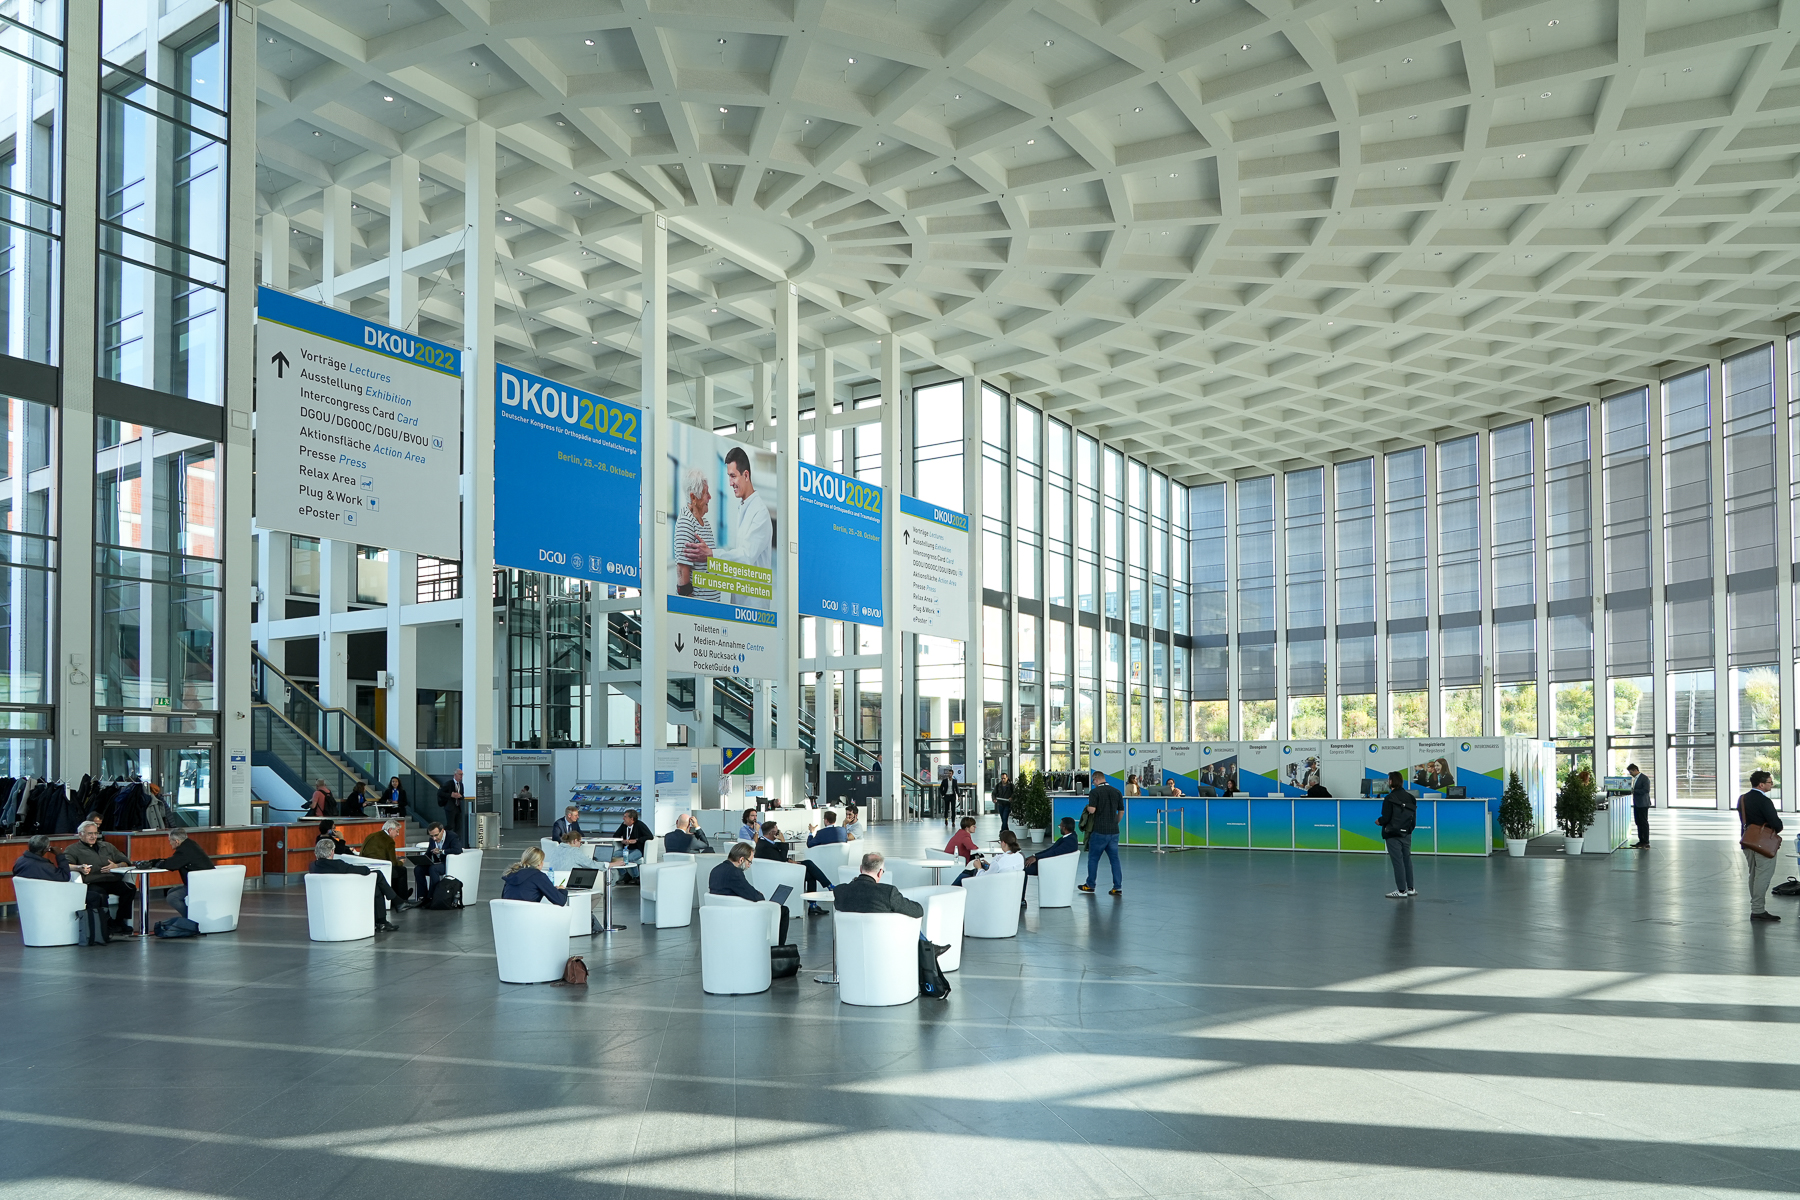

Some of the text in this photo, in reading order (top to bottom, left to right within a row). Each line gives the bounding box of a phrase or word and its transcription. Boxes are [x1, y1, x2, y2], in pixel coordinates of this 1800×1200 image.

[365, 326, 454, 370] DKOU2022
[301, 348, 391, 383] Vorträge Lectures
[301, 369, 411, 407] Ausstellung Exhibition
[301, 388, 418, 426] Intercongress Card Card
[502, 372, 636, 442] DKOU2022
[300, 407, 428, 446] DGOU/DGOOC/DGU/BVOU
[502, 410, 529, 424] Deutscher
[531, 419, 555, 433] Kongress
[565, 429, 591, 442] Orthopädie
[602, 440, 636, 455] Unfallchirurgie
[300, 427, 425, 464] Aktionsfläche Action Area
[300, 445, 366, 469] Presse Press
[558, 451, 582, 466] Berlin,
[610, 465, 636, 479] Oktober
[300, 465, 356, 485] Relax Area
[300, 485, 323, 500] Plug
[800, 467, 880, 513] DKOU2022
[299, 506, 340, 521] ePoster
[800, 495, 813, 504] German
[814, 499, 829, 508] Congress
[860, 513, 880, 523] Traumatology
[934, 508, 966, 529] DKOU2022
[833, 524, 848, 534] Berlin,
[913, 527, 944, 541] Vorträge Lectures
[913, 538, 951, 553] Ausstellung Exhibition
[913, 549, 937, 560] Intercongress
[946, 556, 954, 564] Card
[709, 560, 771, 583] Mit Begeisterung
[913, 571, 937, 582] Aktionsfläche
[694, 575, 770, 597] für unsere Patienten
[913, 582, 936, 592] Presse Press
[913, 593, 923, 601] Relax
[735, 608, 775, 624] DKOU2022
[913, 605, 922, 613] Plug
[694, 623, 719, 634] Toiletten
[913, 616, 927, 624] ePoster
[694, 636, 764, 652] Medien-Annahme Centre
[694, 649, 737, 661] O&U Rucksack
[694, 661, 731, 673] PocketGuide
